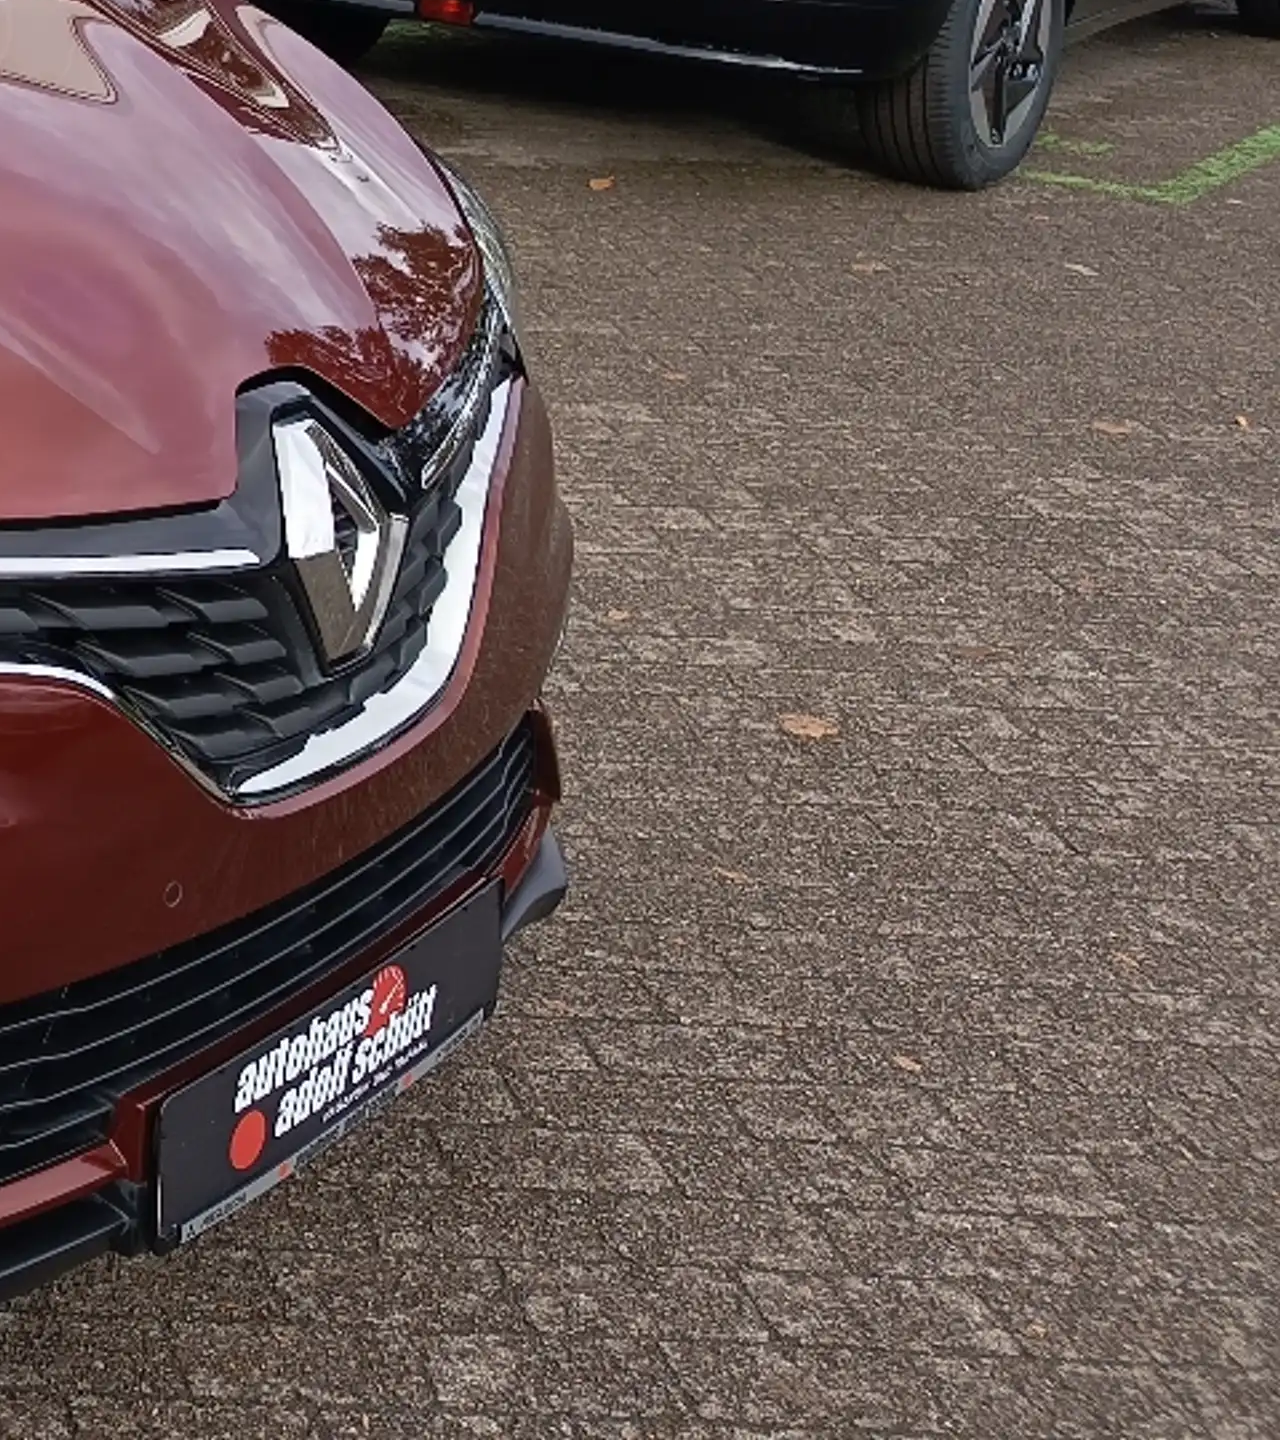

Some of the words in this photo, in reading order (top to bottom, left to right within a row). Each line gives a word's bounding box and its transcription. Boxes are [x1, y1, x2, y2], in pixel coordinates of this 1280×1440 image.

[234, 988, 375, 1114] autohaus
[274, 1041, 355, 1138] adolf
[352, 983, 437, 1084] schütt
